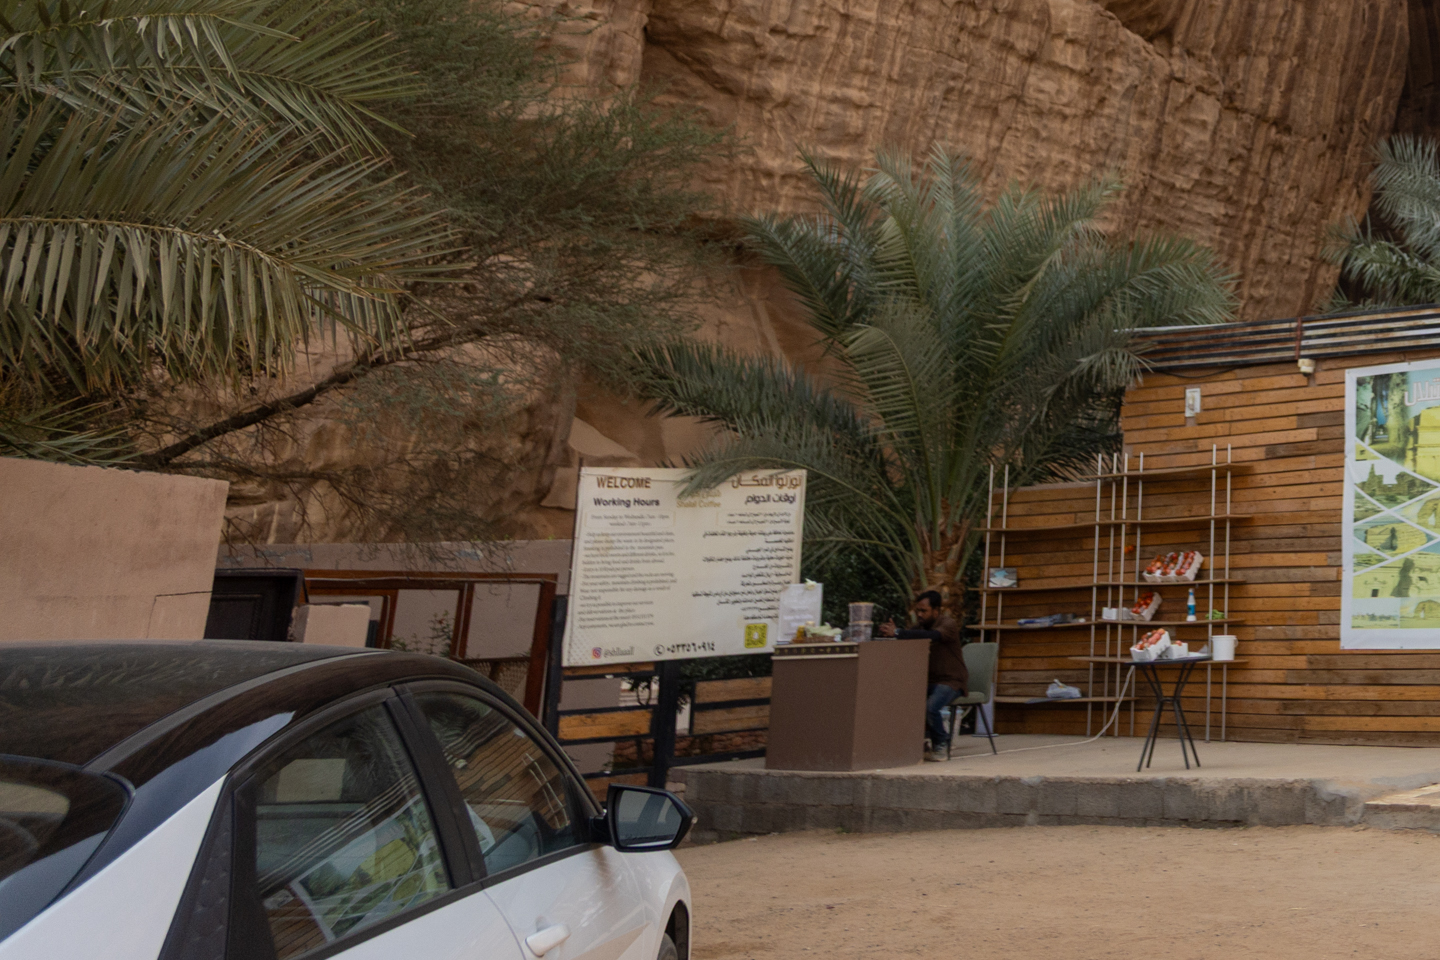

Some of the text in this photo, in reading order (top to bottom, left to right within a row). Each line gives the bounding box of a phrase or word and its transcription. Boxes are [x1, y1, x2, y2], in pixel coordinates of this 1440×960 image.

[596, 476, 652, 489] WELCOME
[593, 497, 660, 508] Working Hours
